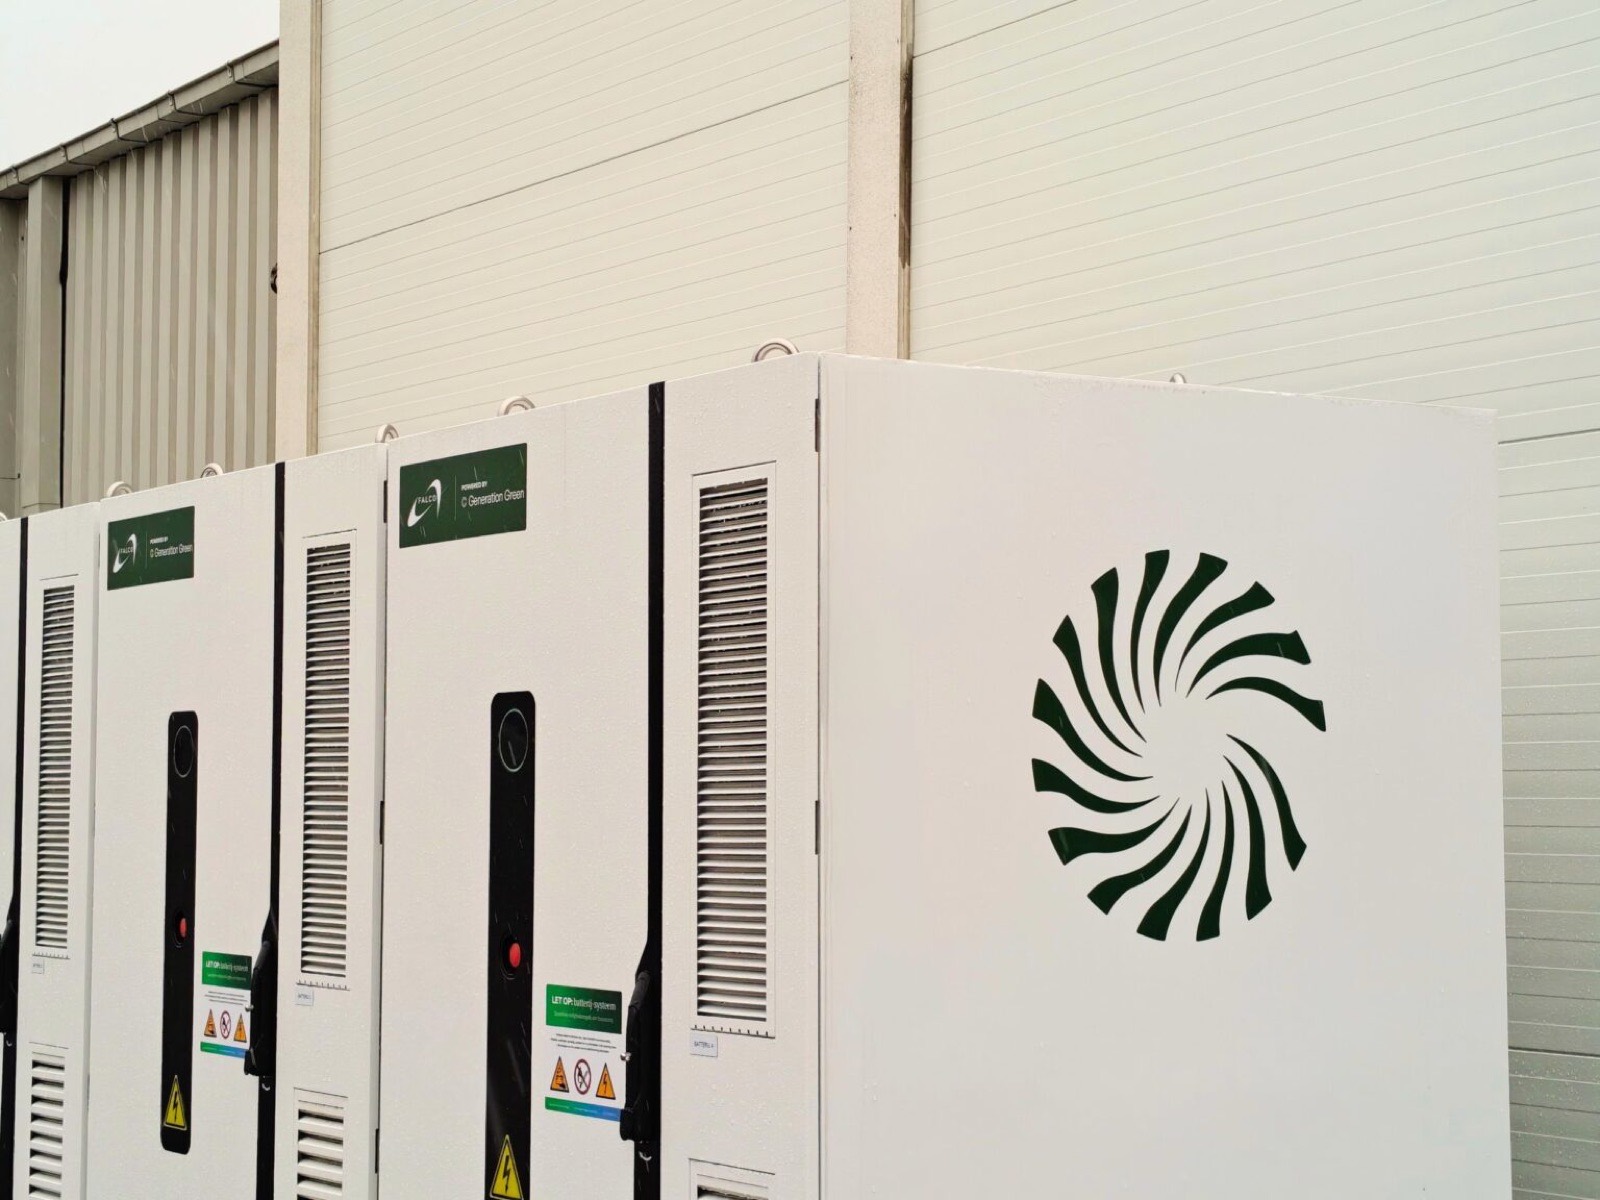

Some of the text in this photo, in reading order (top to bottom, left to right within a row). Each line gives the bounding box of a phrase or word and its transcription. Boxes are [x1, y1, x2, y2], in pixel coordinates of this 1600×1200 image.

[461, 480, 488, 491] POWERED BY
[468, 489, 525, 506] Generation Green
[155, 543, 193, 557] Generation Green
[551, 995, 562, 1004] LET
[562, 996, 574, 1006] OP:
